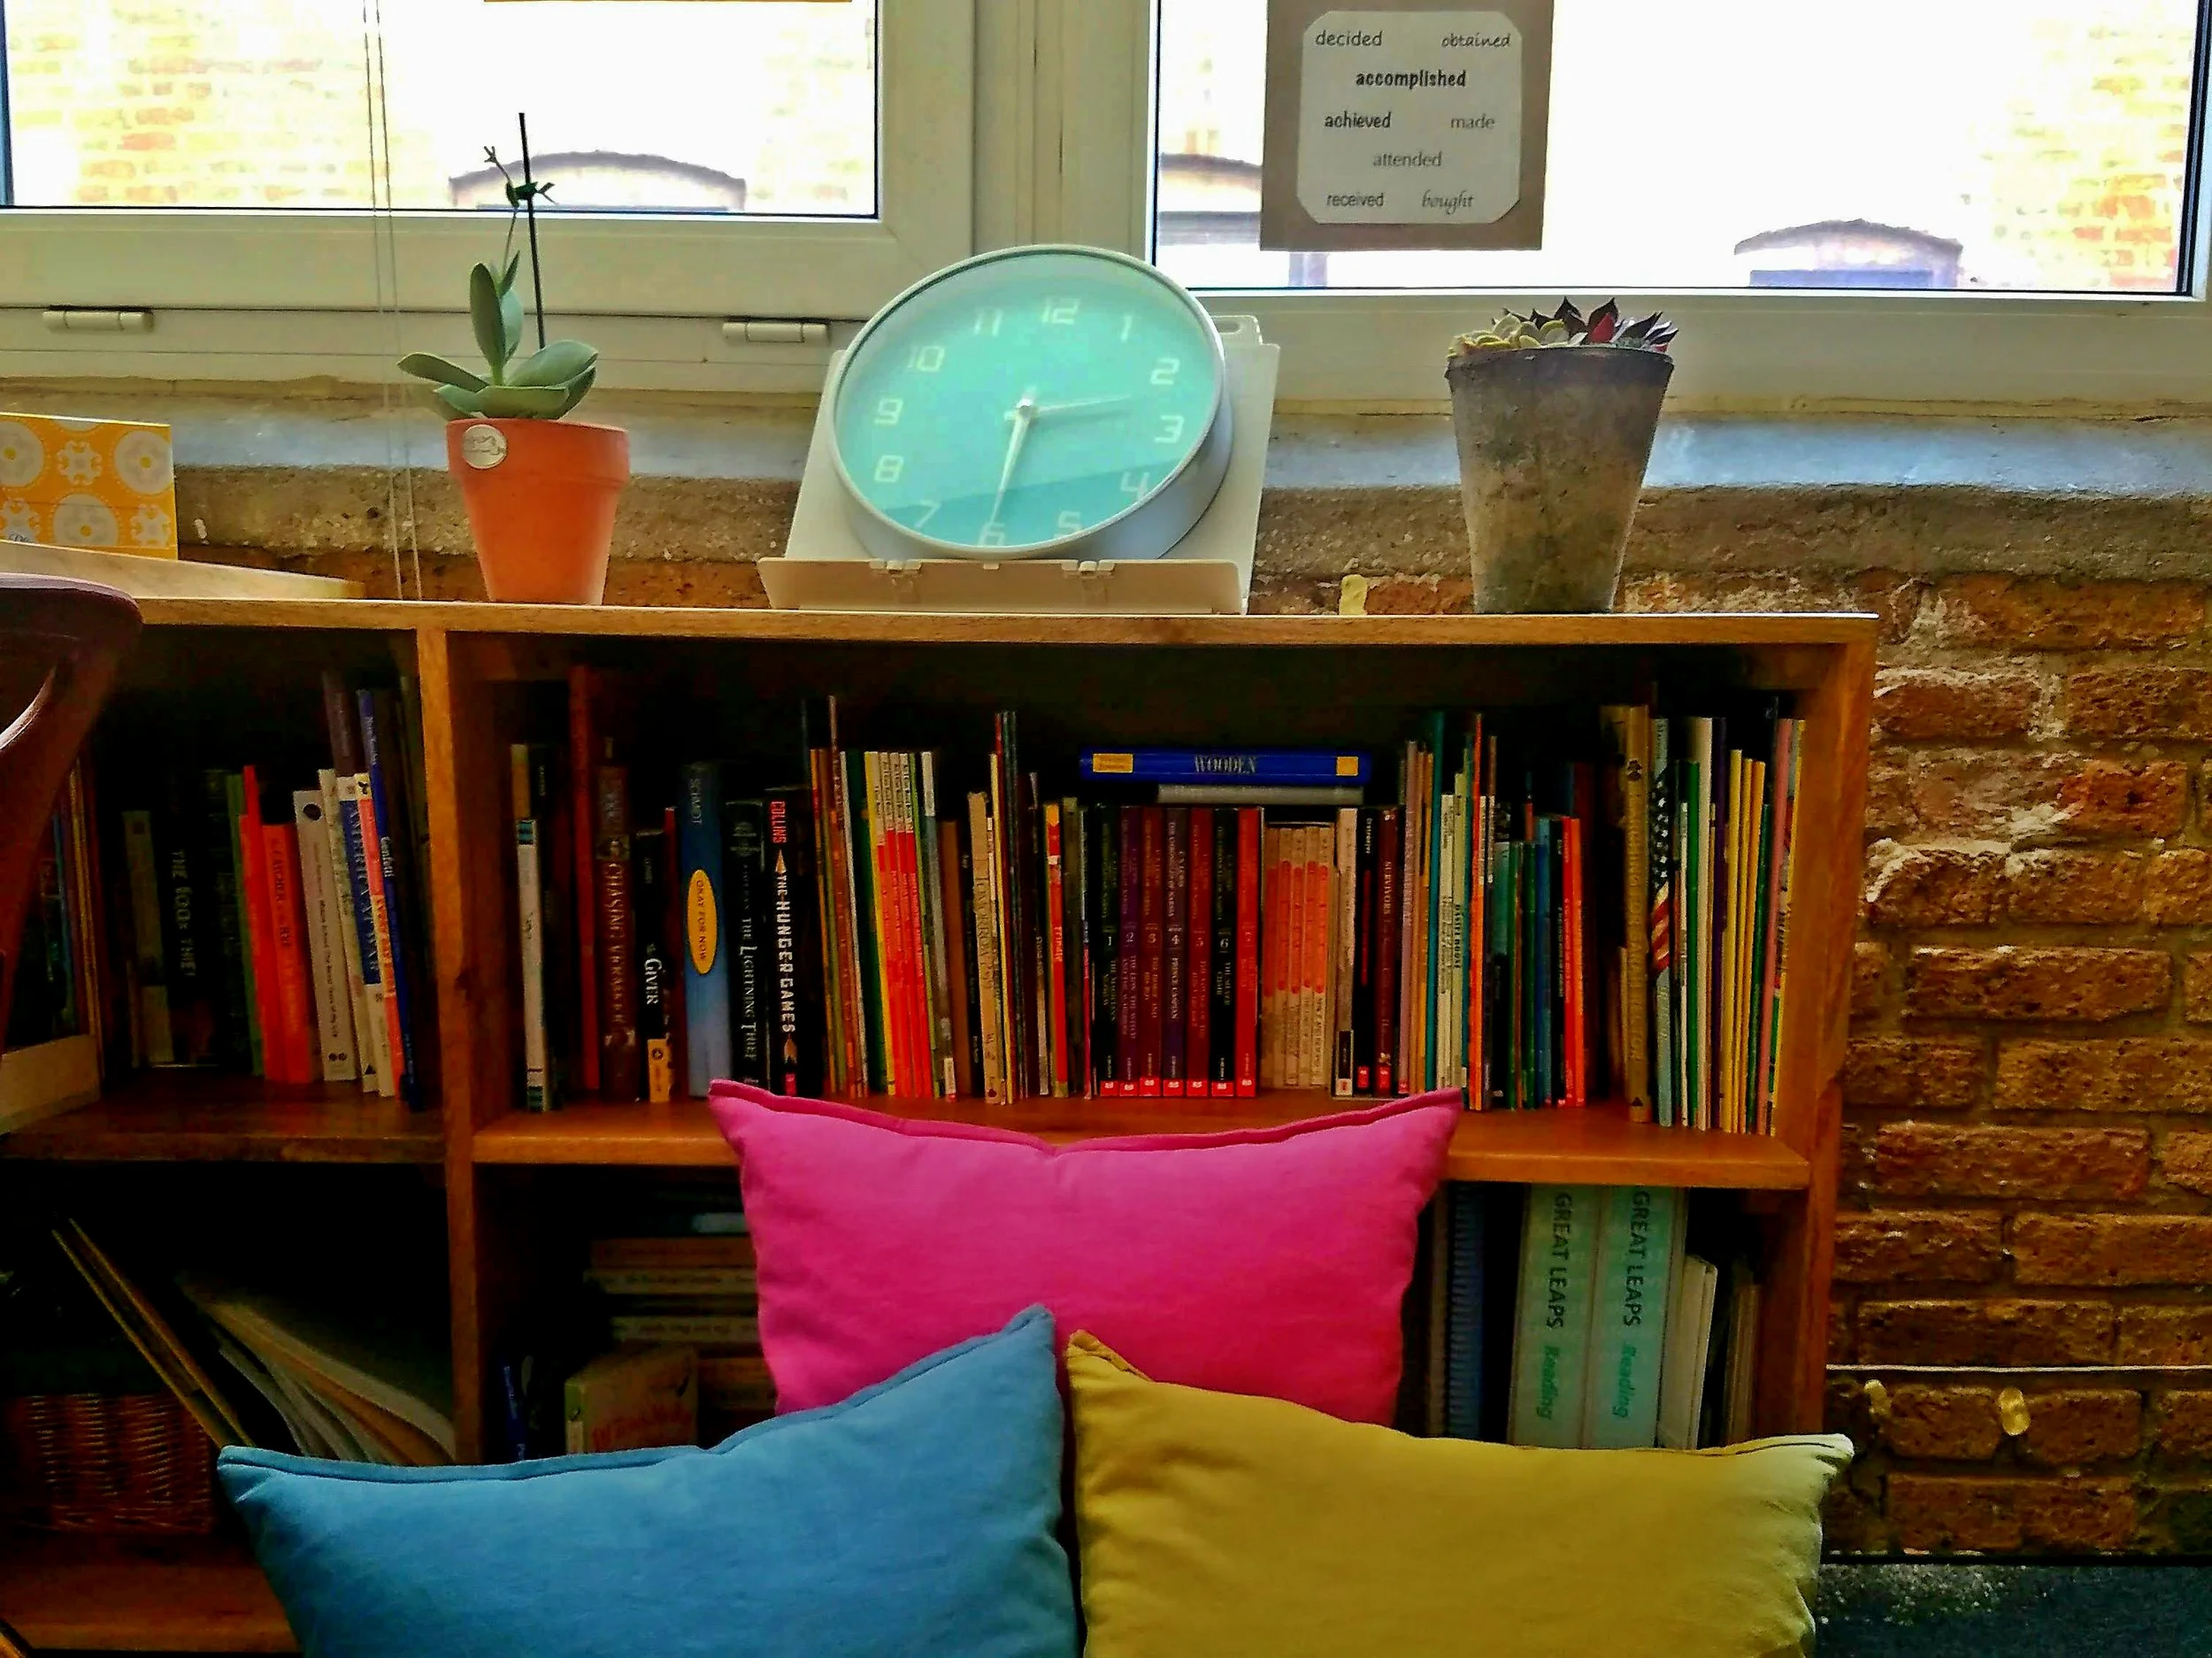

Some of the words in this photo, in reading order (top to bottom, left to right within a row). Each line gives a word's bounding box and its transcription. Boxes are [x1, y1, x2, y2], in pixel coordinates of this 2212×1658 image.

[1315, 30, 1383, 47] decided
[1441, 33, 1510, 49] obtained
[1356, 69, 1466, 89] accomplished
[1325, 111, 1392, 128] achieved
[1450, 113, 1495, 129] made
[1372, 151, 1442, 167] attended
[1326, 192, 1384, 207] received
[1422, 189, 1473, 214] bought
[974, 309, 1002, 336] 11
[1041, 297, 1079, 325] 12
[1120, 315, 1134, 342] 1
[909, 345, 945, 372] 10
[1150, 357, 1180, 385] 2
[874, 397, 902, 426] 9
[1154, 416, 1184, 443] 3
[874, 455, 903, 483] 8
[1120, 472, 1149, 502] 4
[916, 501, 941, 528] 7
[1055, 511, 1083, 537] 5
[978, 523, 1007, 547] 6
[1195, 756, 1257, 775] WOODEN
[771, 801, 787, 844] COLLINS
[696, 880, 705, 908] OKAY
[777, 875, 787, 895] THE
[742, 917, 752, 940] THE
[777, 901, 792, 972] HUNGER
[1108, 936, 1112, 946] 1
[1125, 932, 1134, 942] 2
[1147, 933, 1156, 943] 3
[1171, 934, 1179, 945] 4
[1219, 938, 1229, 948] 6
[644, 958, 663, 1005] GIVER
[738, 946, 757, 1017] LIGHTNING
[780, 979, 795, 1032] GAMES
[741, 1022, 757, 1061] THIEF
[1552, 1193, 1572, 1260] GREAT
[1628, 1191, 1649, 1259] GREAT
[1546, 1267, 1568, 1328] LEAPS
[1623, 1264, 1645, 1327] LEAPS
[1536, 1345, 1561, 1420] Reading
[1612, 1344, 1637, 1418] Reading
